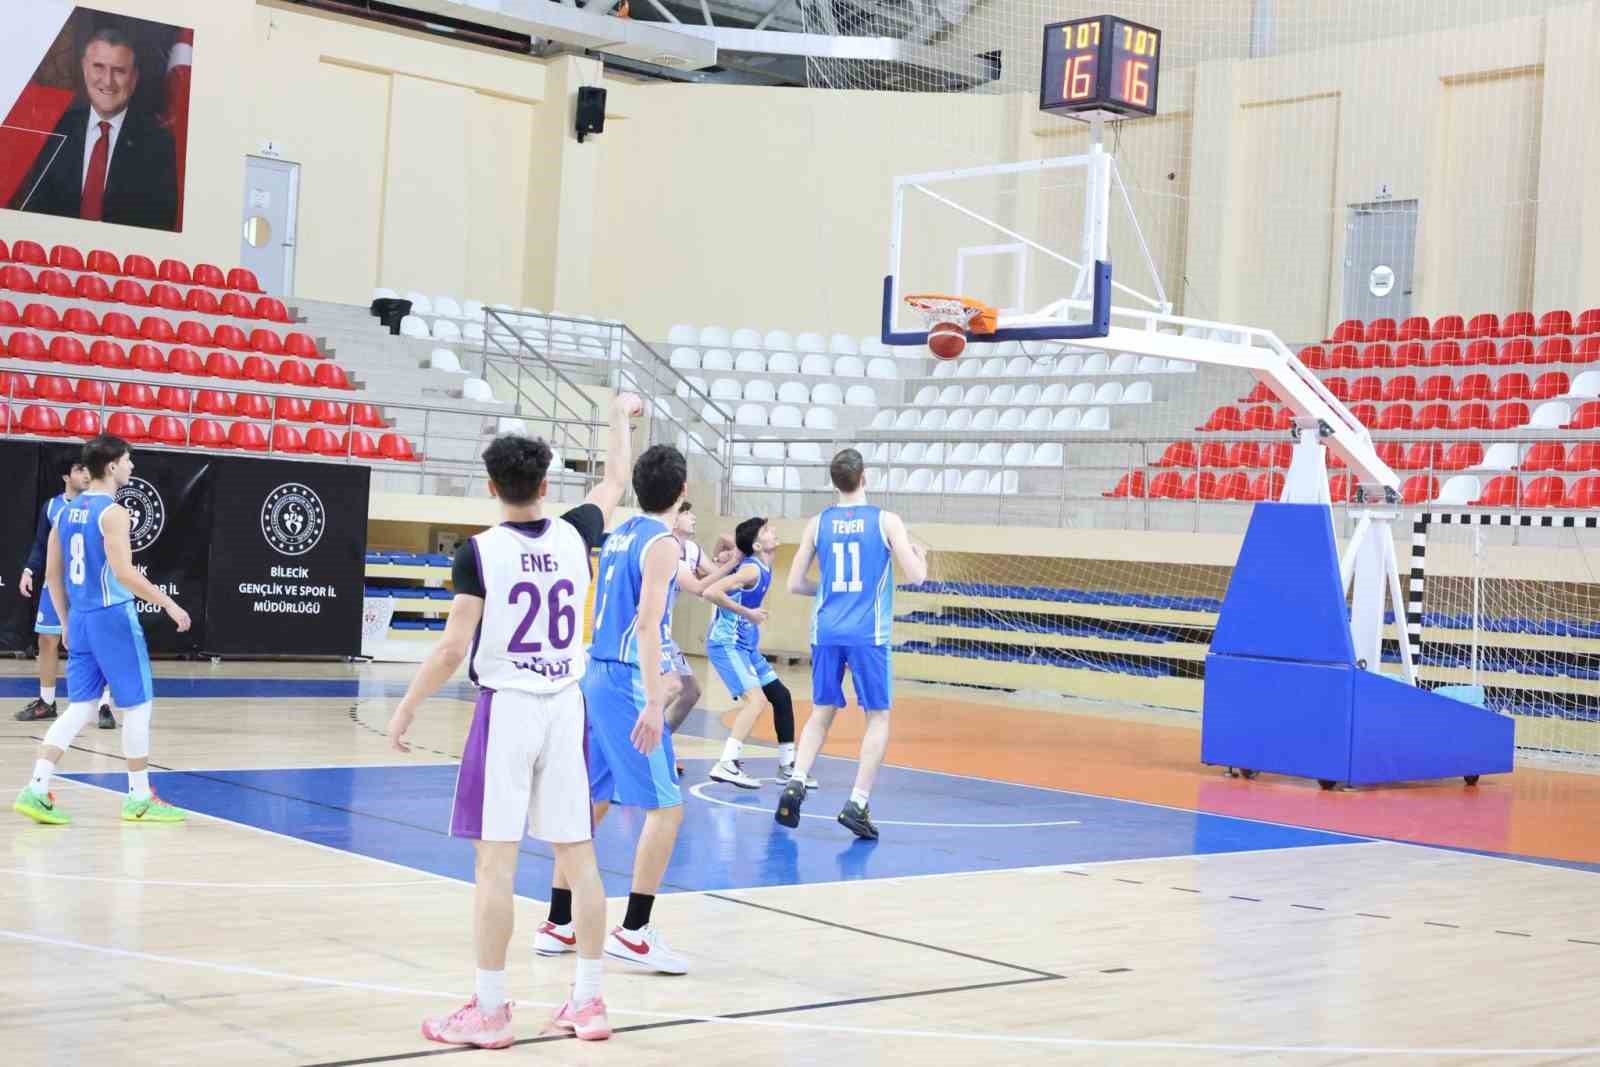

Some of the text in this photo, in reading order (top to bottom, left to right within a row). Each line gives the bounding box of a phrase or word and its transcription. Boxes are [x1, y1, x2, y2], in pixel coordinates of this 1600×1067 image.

[1063, 55, 1094, 100] 16
[1124, 60, 1149, 106] 16
[69, 533, 86, 585] 8
[270, 565, 309, 579] BİLECİK
[831, 542, 863, 593] 11
[238, 582, 337, 598] GENÇLİK VE SPOR İL
[253, 601, 321, 615] MÜDÜRLÜĞÜ
[507, 578, 576, 653] 26
